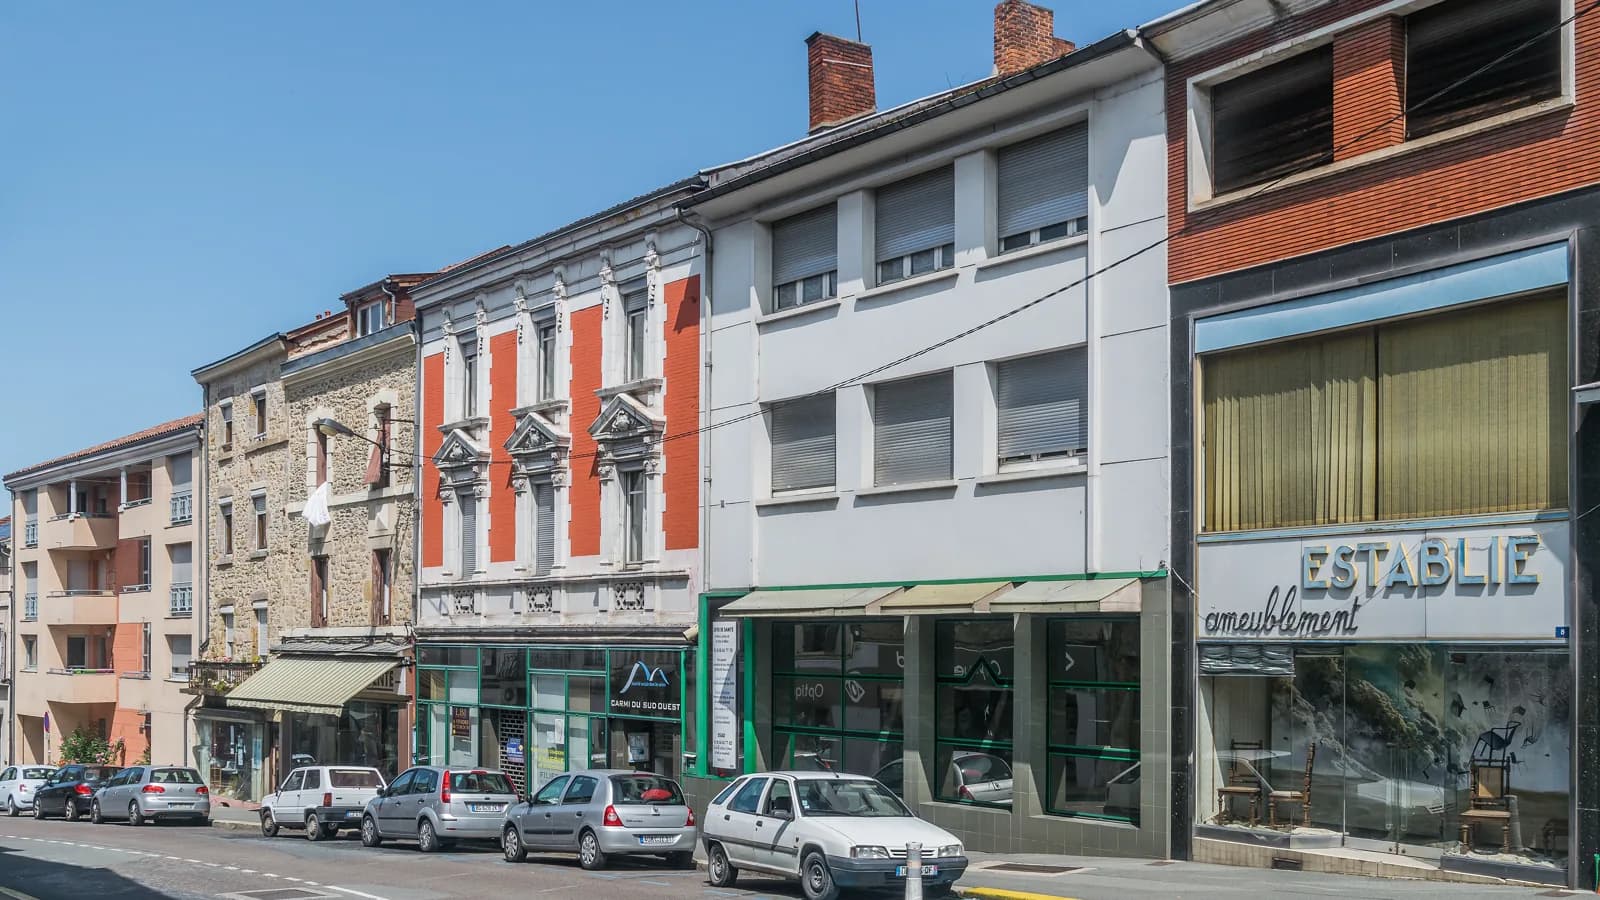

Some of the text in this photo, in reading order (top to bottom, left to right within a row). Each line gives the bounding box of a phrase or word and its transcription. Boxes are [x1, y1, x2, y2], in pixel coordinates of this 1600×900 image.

[1303, 535, 1542, 589] ESTABLIE
[1205, 585, 1362, 632] ameublement
[610, 699, 681, 711] CARMI DU SUD OUEST
